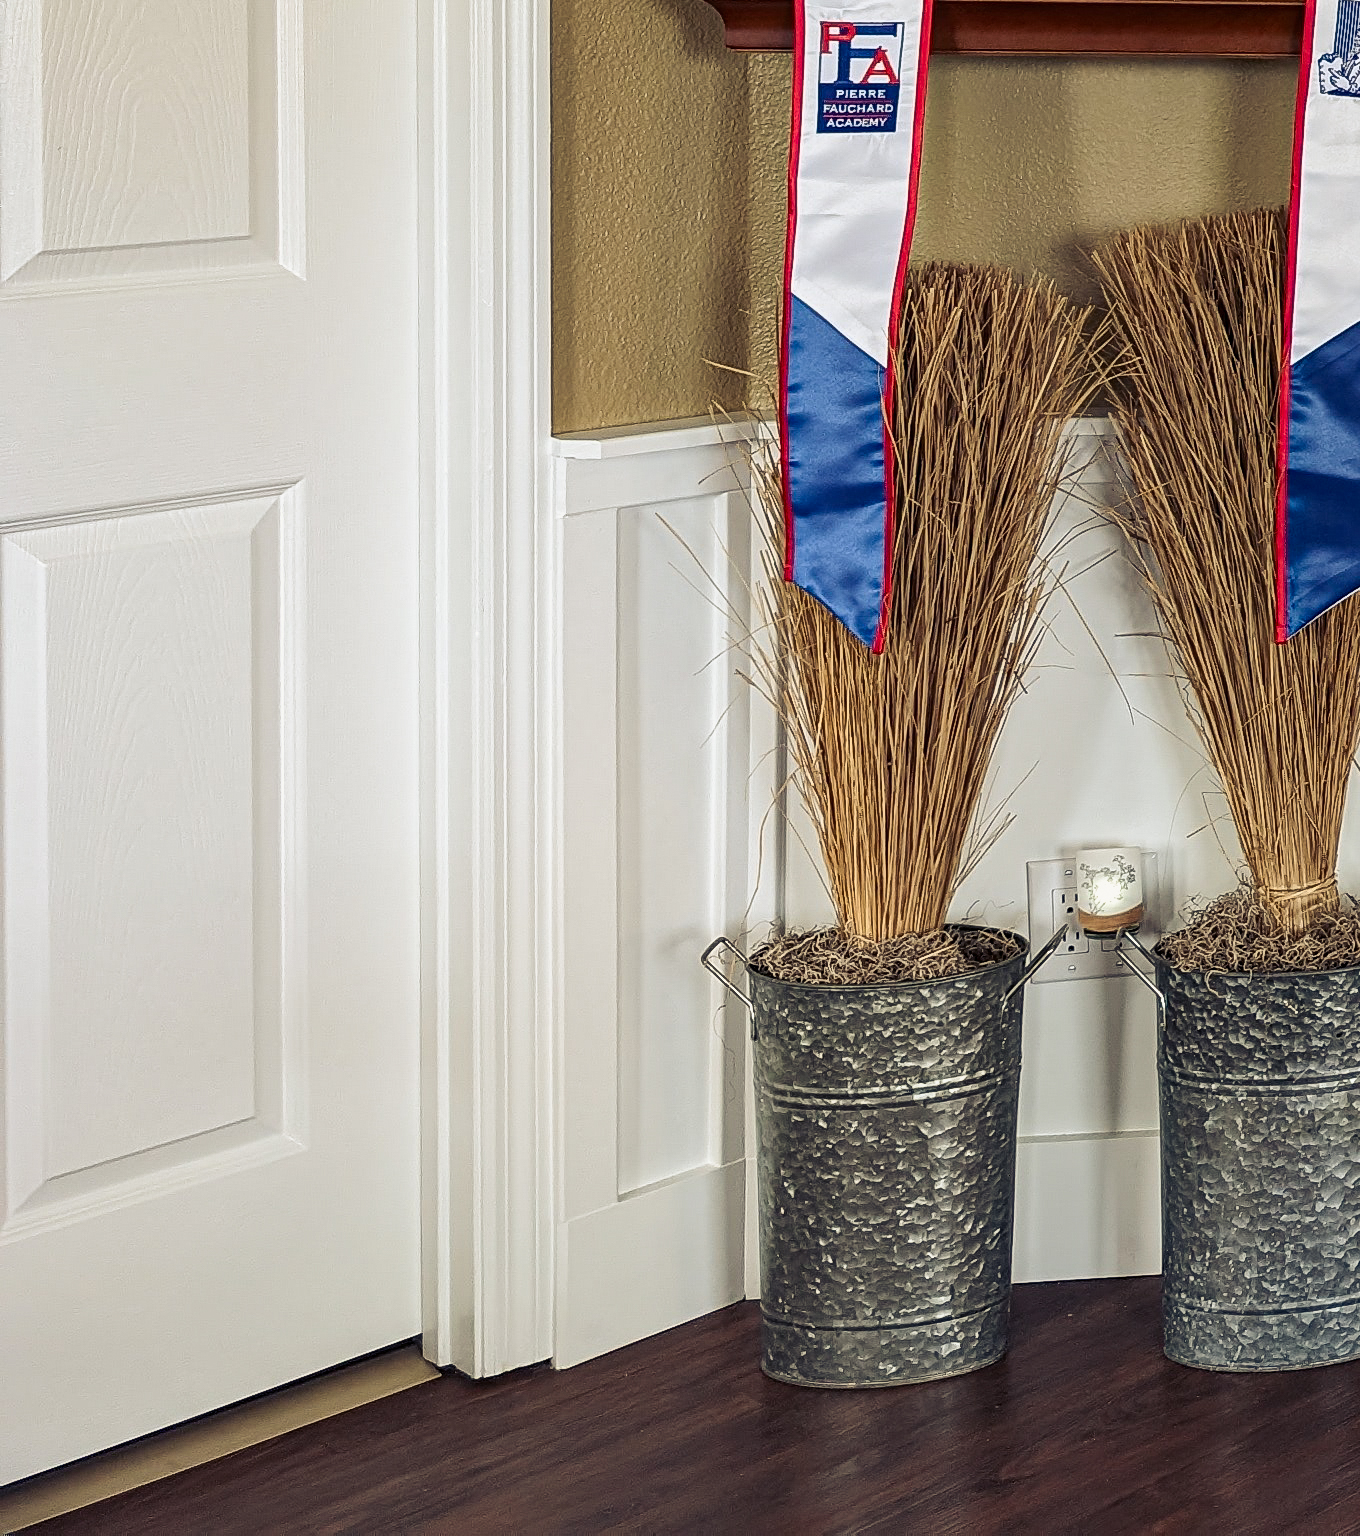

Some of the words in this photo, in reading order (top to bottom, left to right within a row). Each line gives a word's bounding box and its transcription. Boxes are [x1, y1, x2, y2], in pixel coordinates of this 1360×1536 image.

[836, 89, 887, 99] PIERRE
[823, 103, 894, 114] FAUCHARD
[826, 117, 888, 128] ACADEMY
